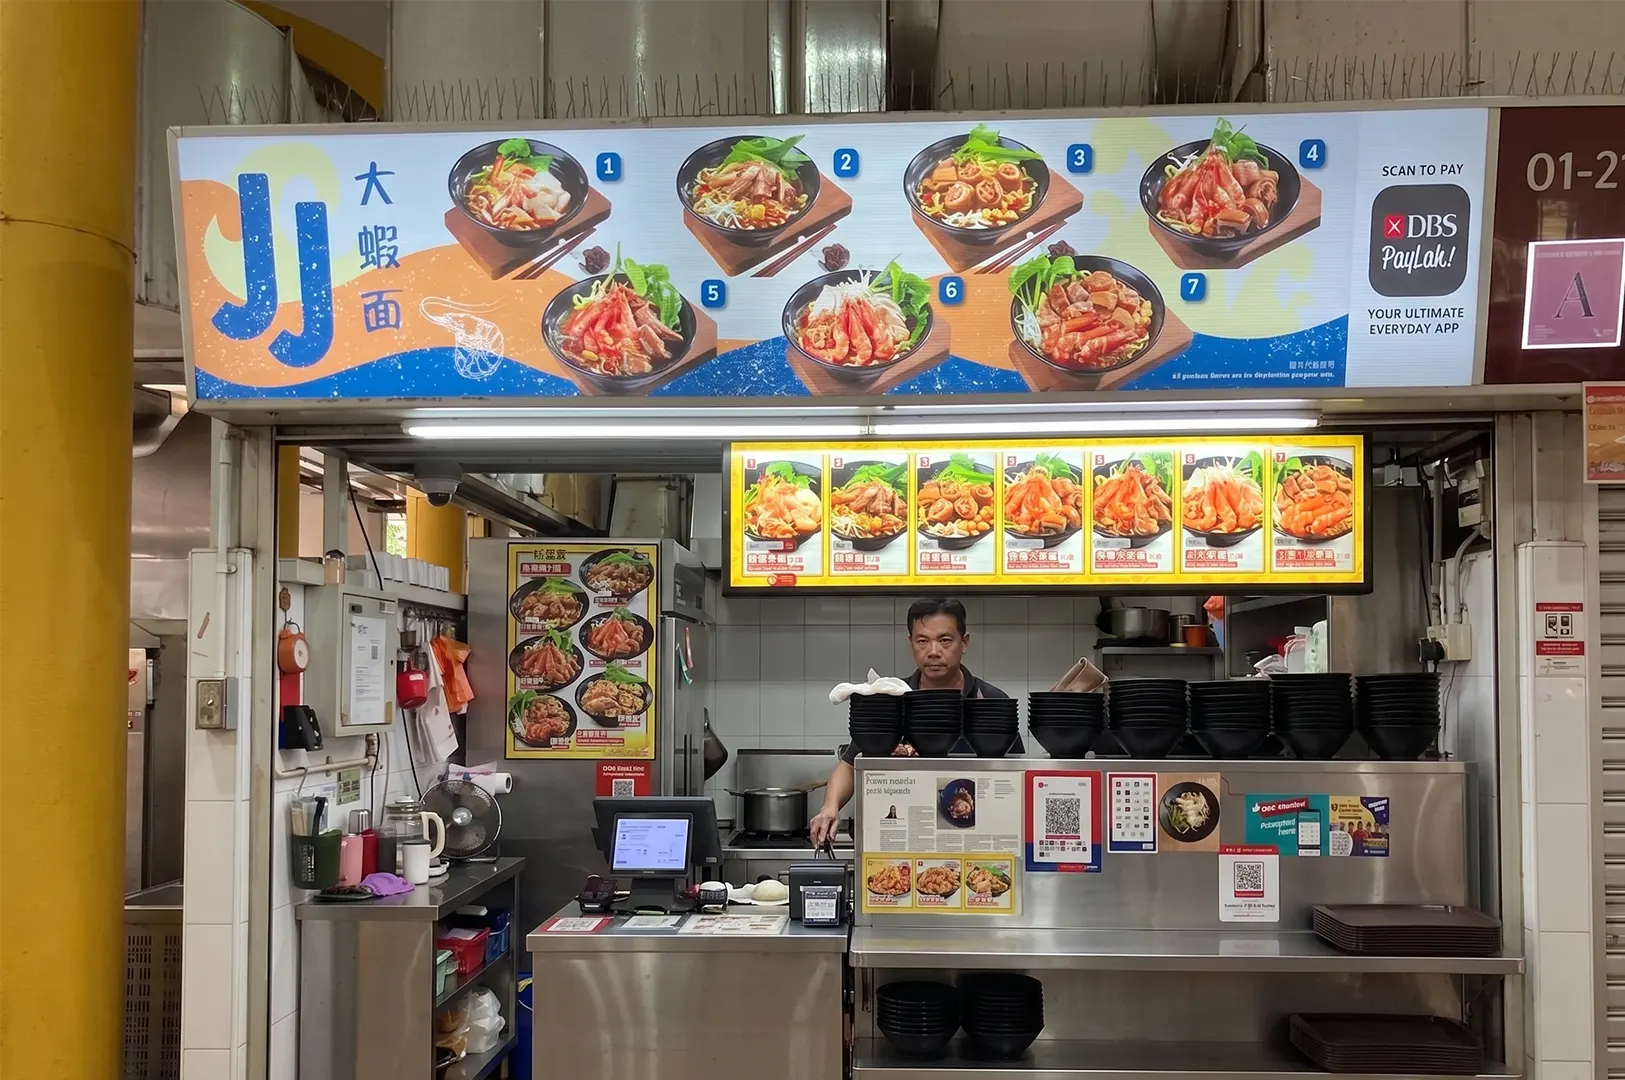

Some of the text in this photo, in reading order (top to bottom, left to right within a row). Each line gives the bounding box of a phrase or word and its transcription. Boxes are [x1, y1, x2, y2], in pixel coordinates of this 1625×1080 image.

[1074, 149, 1085, 166] 3
[1306, 144, 1319, 161] 4
[603, 157, 614, 174] 1
[840, 153, 852, 170] 2
[1382, 163, 1464, 177] SCAN TO PAY
[1526, 150, 1625, 192] 01-2
[1407, 213, 1458, 238] DBS
[354, 160, 403, 333] 大蝦面
[1381, 243, 1457, 274] PayLah!
[211, 172, 334, 368] JJ
[708, 285, 719, 302] 5
[945, 281, 957, 298] 6
[1188, 278, 1199, 295] 7
[1552, 271, 1596, 319] A
[1368, 307, 1464, 319] YOUR ULTIMATE
[1369, 323, 1459, 335] EVERYDAY APP
